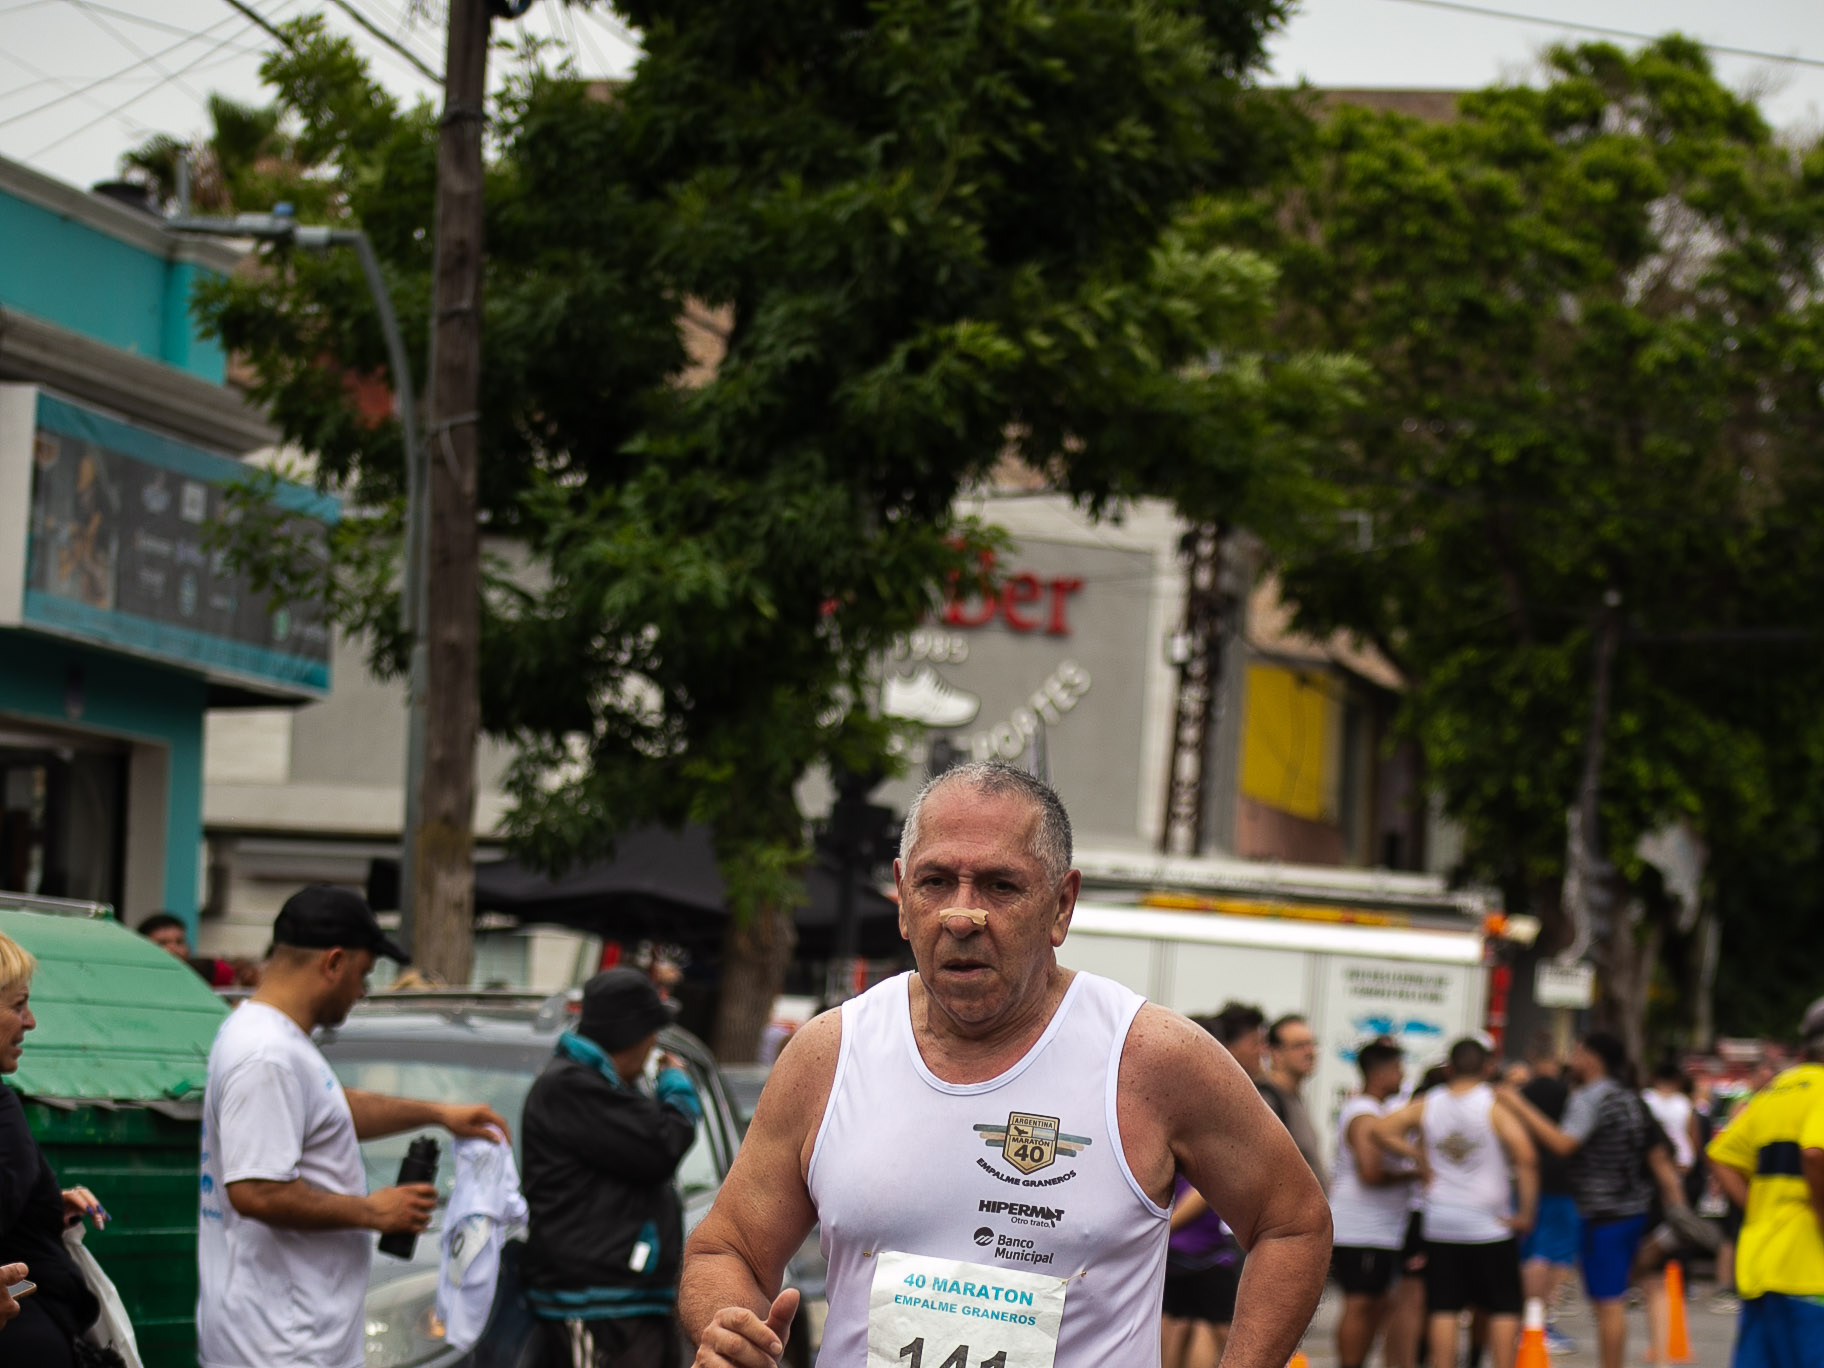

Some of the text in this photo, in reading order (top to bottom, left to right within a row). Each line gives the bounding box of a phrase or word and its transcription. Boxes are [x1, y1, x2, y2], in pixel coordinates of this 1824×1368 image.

[1014, 1117, 1053, 1129] ARGENTINA
[1013, 1144, 1045, 1164] 40
[976, 1157, 1077, 1188] EMPALME GRANEROS
[1010, 1216, 1029, 1225] Otro
[997, 1234, 1034, 1249] Banco
[994, 1247, 1055, 1265] Municipal
[903, 1273, 1034, 1307] 40 MARATON
[894, 1294, 1036, 1326] EMPALME GRANEROS
